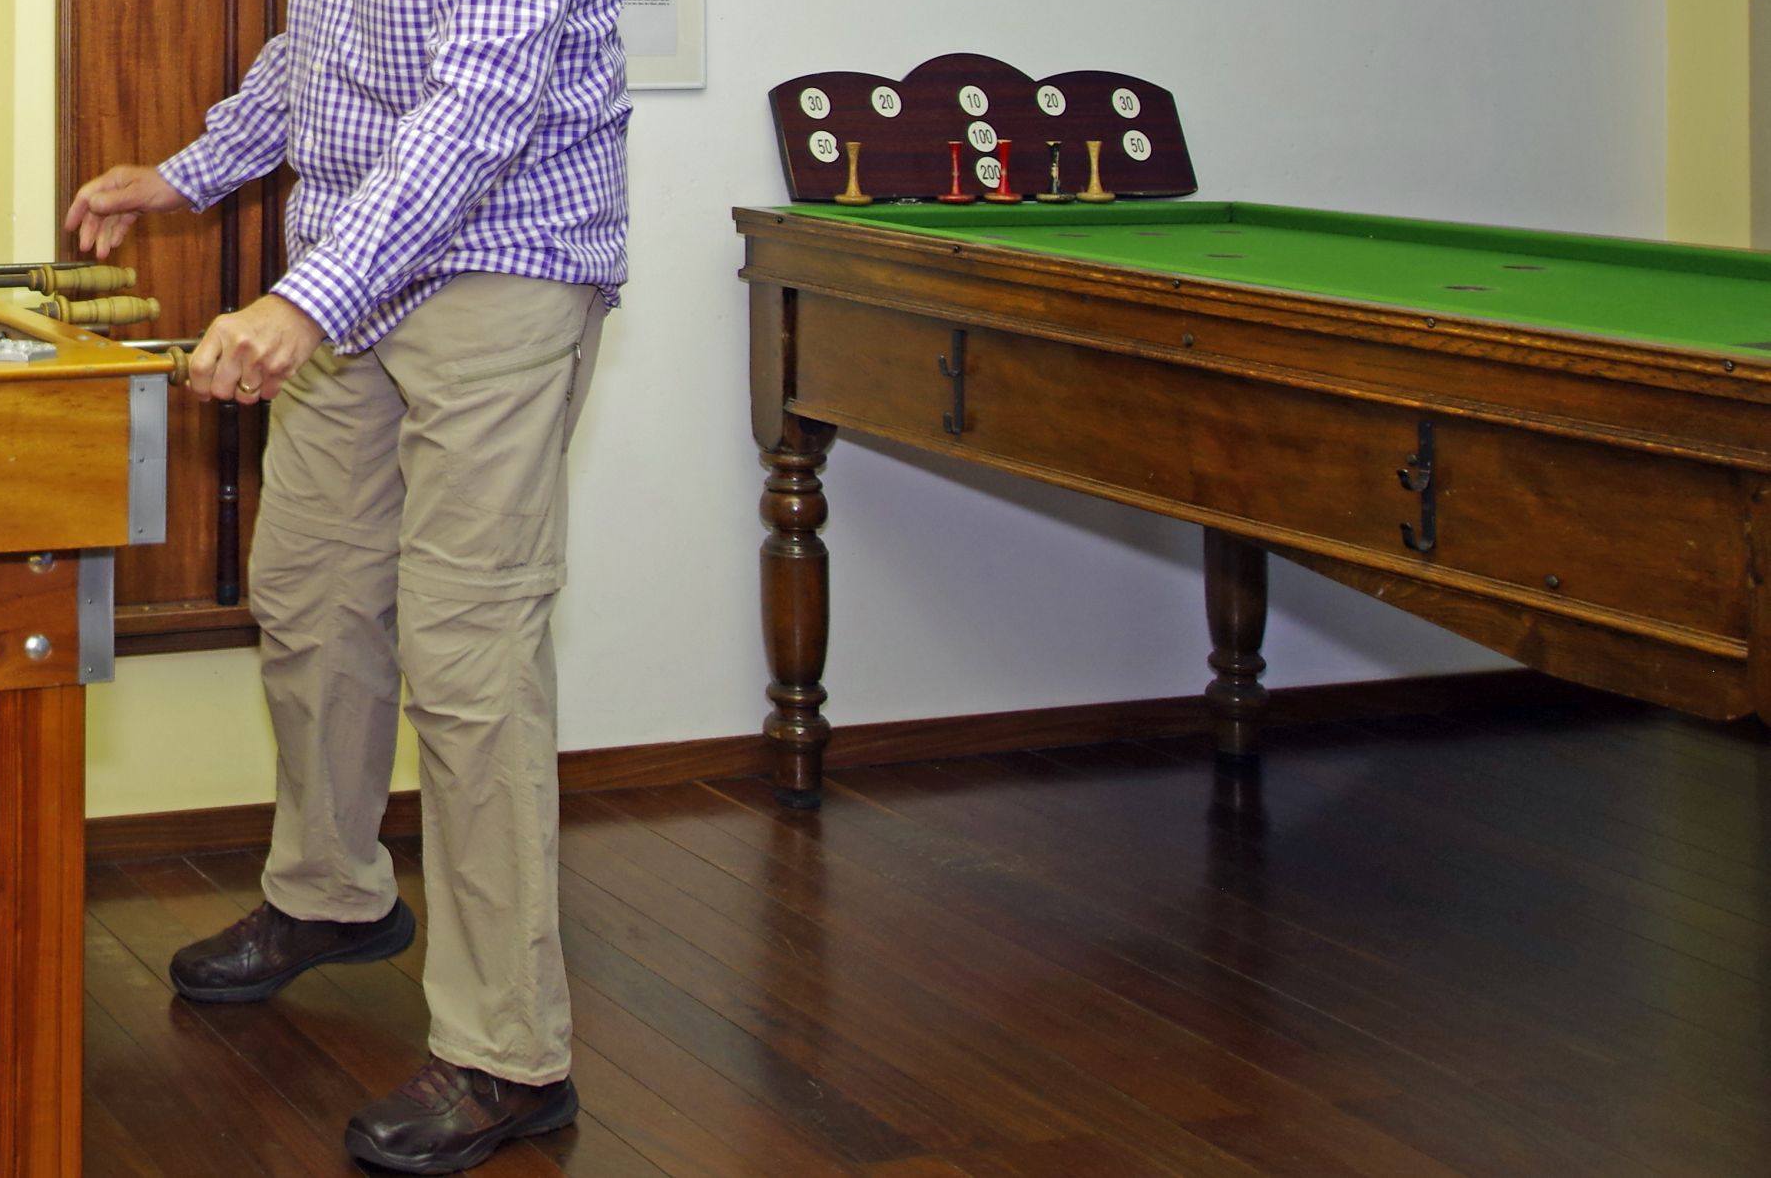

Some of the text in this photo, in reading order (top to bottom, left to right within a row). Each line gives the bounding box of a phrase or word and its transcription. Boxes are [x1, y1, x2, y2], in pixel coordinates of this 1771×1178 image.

[808, 95, 823, 112] 30
[879, 94, 894, 110] 20
[966, 93, 981, 109] 10
[1044, 93, 1059, 109] 20
[1119, 95, 1134, 111] 30
[972, 129, 993, 145] 100
[1130, 137, 1145, 153] 50
[817, 139, 833, 155] 50
[980, 165, 1001, 181] 200
